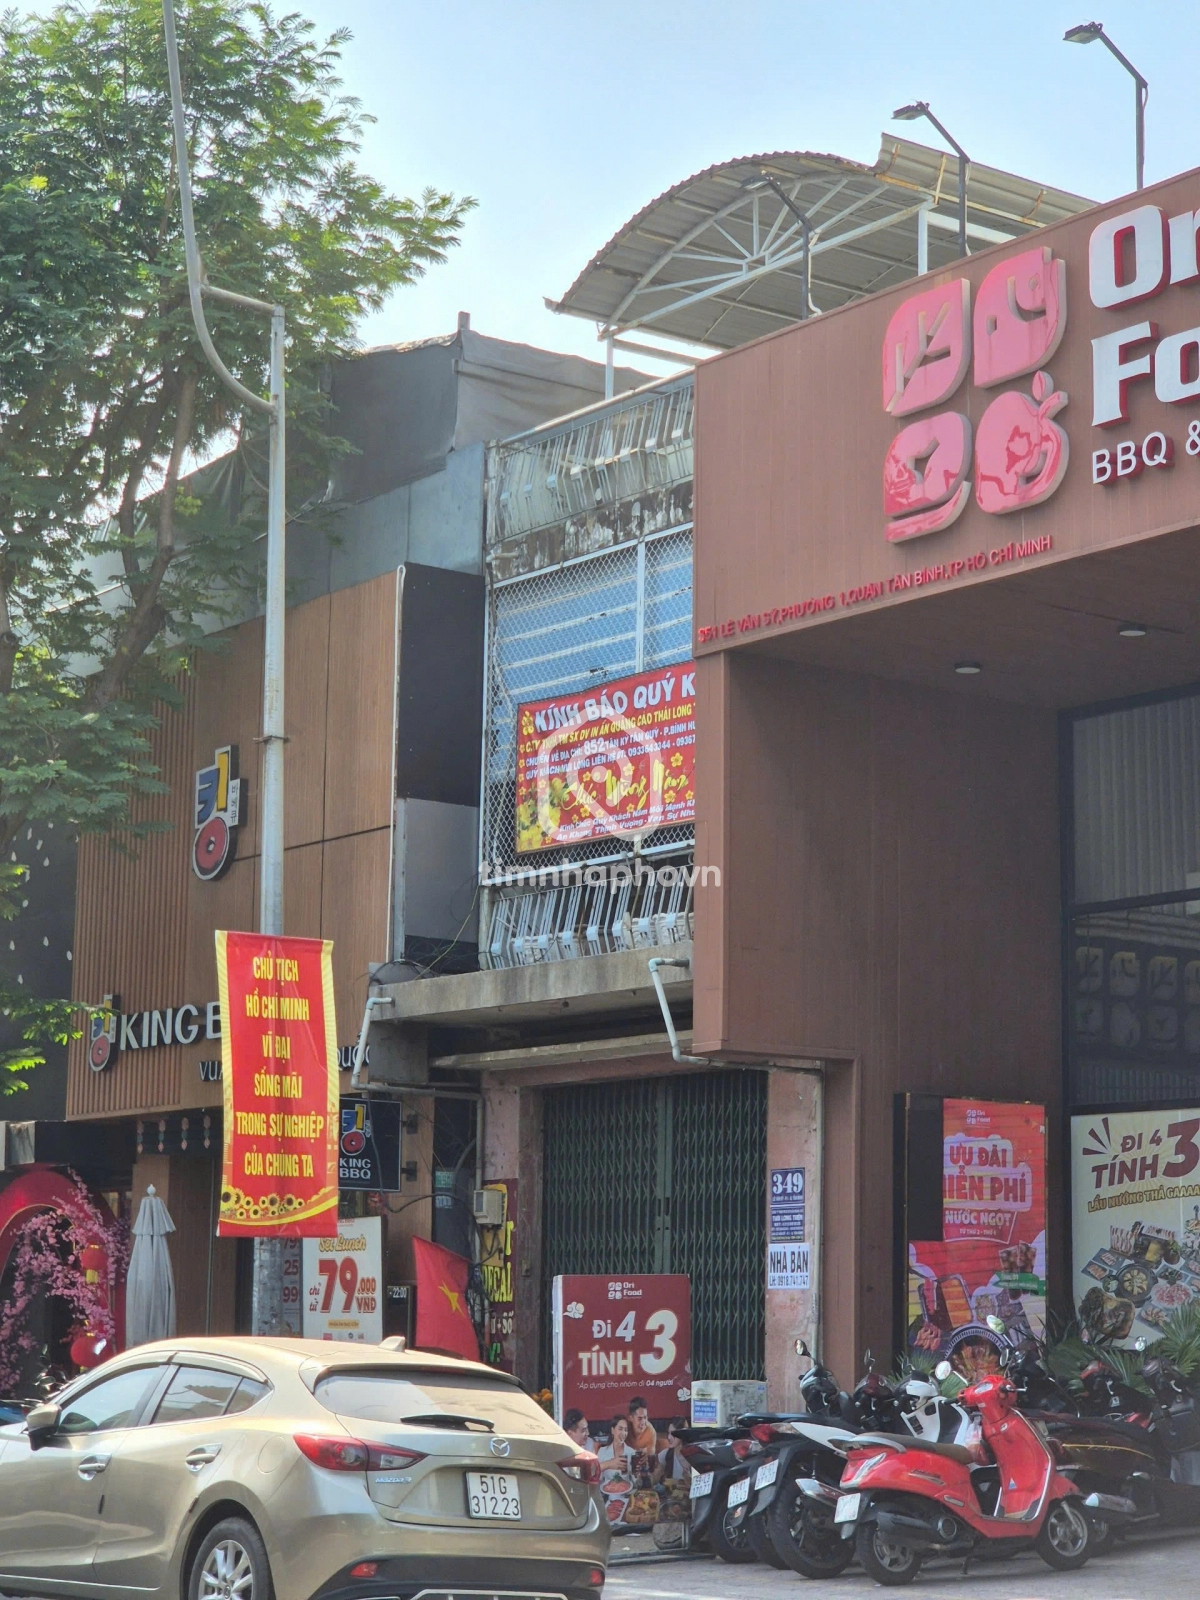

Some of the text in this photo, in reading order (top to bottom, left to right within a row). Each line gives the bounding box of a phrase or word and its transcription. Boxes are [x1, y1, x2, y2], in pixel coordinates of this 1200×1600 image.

[1092, 431, 1168, 485] BBQ
[989, 541, 1014, 565] CHÍ
[1015, 535, 1053, 559] MINH
[535, 702, 581, 733] KÍNH
[585, 689, 627, 721] BÁO
[633, 673, 675, 709] QUÝ
[654, 705, 670, 722] THÁI
[672, 704, 691, 718] LONG
[583, 736, 605, 755] 852
[253, 950, 299, 986] CHỦ TỊCH
[262, 992, 278, 1019] CHÍ
[280, 997, 310, 1021] MINH
[120, 1003, 199, 1051] KING
[262, 1030, 291, 1064] VĨ ĐẠI
[254, 1066, 303, 1099] SỐNG MÃI
[236, 1110, 324, 1143] TRONG SỰ NGHIỆP
[244, 1144, 314, 1178] CỦA CHÚNG TA
[1121, 1118, 1200, 1178] ĐI 4 3
[340, 1157, 371, 1169] KING
[340, 1168, 371, 1180] BBQ
[1091, 1154, 1159, 1189] TÍNH
[772, 1172, 804, 1195] 349
[990, 1172, 1026, 1202] PHÍ
[945, 1209, 1012, 1229] NƯỚC NGỌT
[336, 1233, 367, 1252] Lunch
[769, 1245, 809, 1274] NHÀ BÁN
[392, 1288, 407, 1298] 22:00
[623, 1281, 636, 1289] Ori
[623, 1289, 643, 1297] Food
[355, 1296, 377, 1313] VNĐ
[592, 1309, 679, 1375] Đi 4 3
[578, 1345, 633, 1376] TÍNH
[480, 1475, 507, 1495] 51G
[472, 1496, 520, 1516] 312.23
